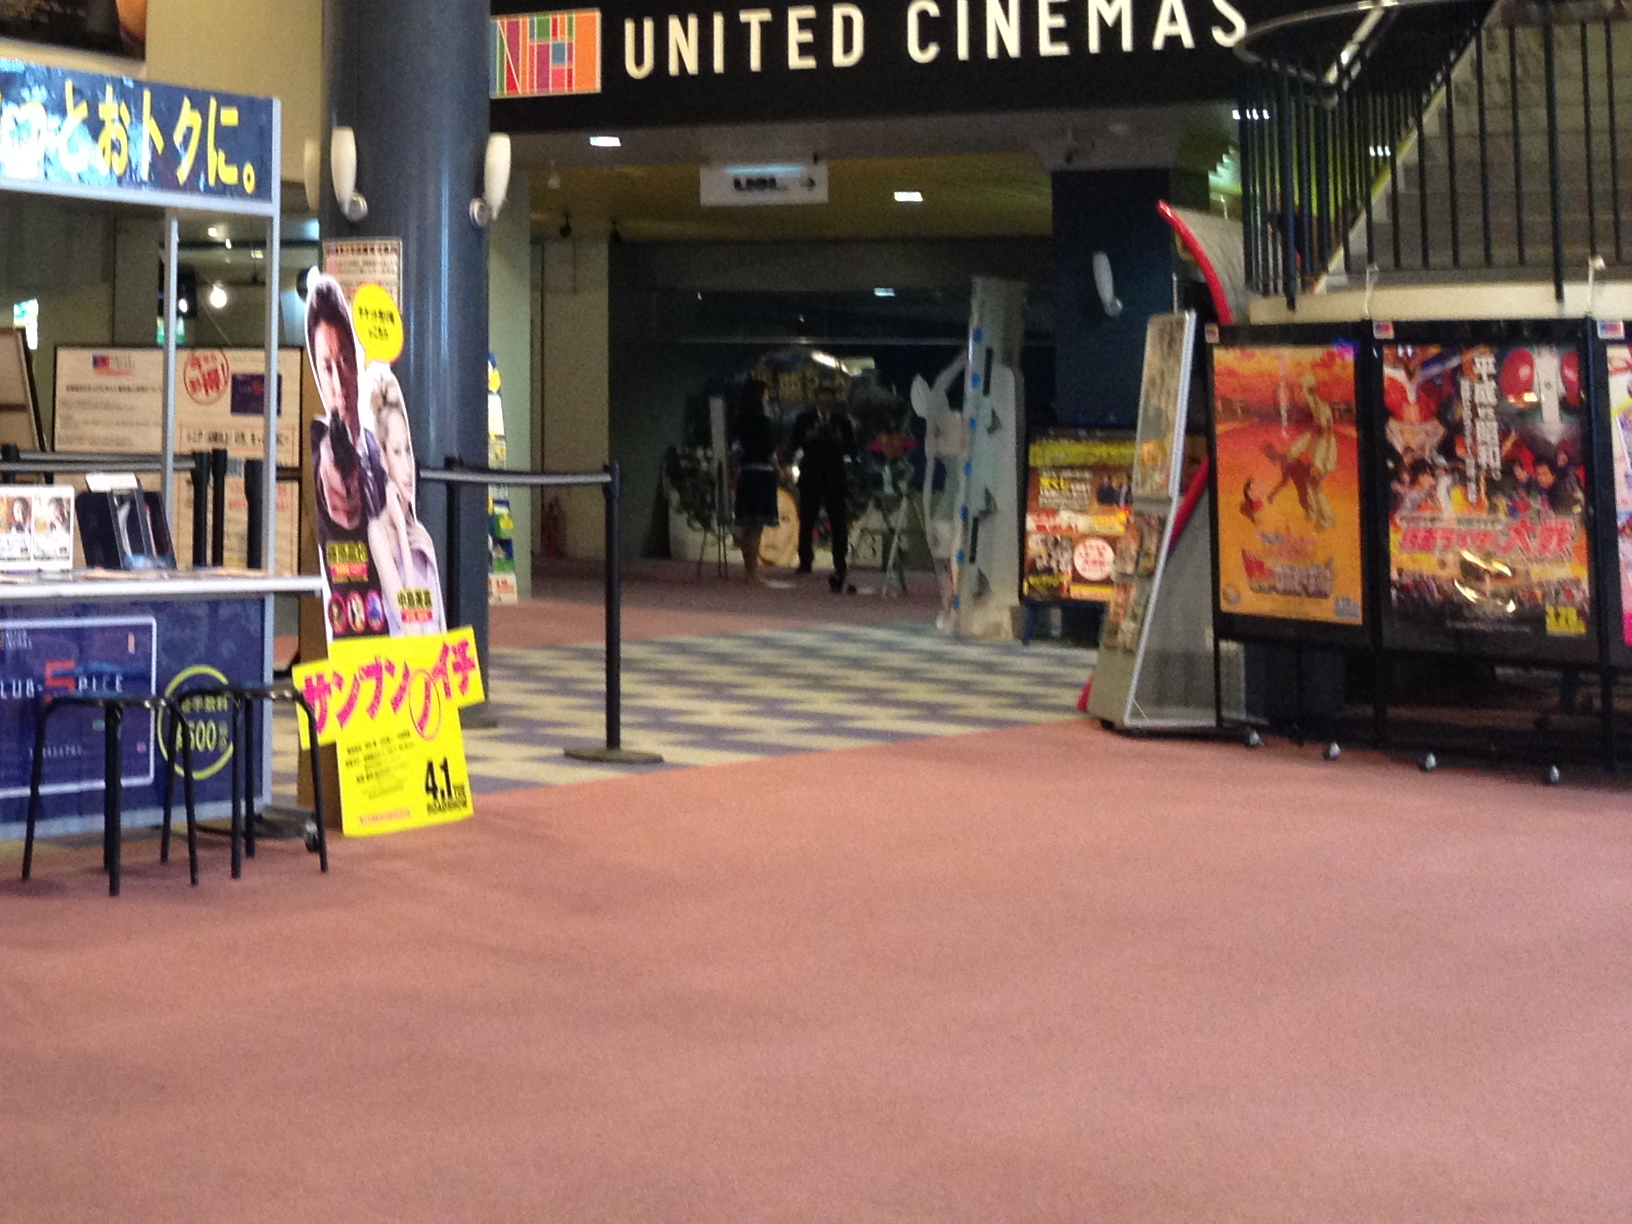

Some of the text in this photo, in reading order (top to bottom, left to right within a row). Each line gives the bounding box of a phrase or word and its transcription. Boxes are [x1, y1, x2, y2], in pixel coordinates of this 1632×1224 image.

[624, 3, 865, 78] UNITED
[301, 638, 476, 735] サンブンノイチ
[424, 757, 454, 800] 4.1
